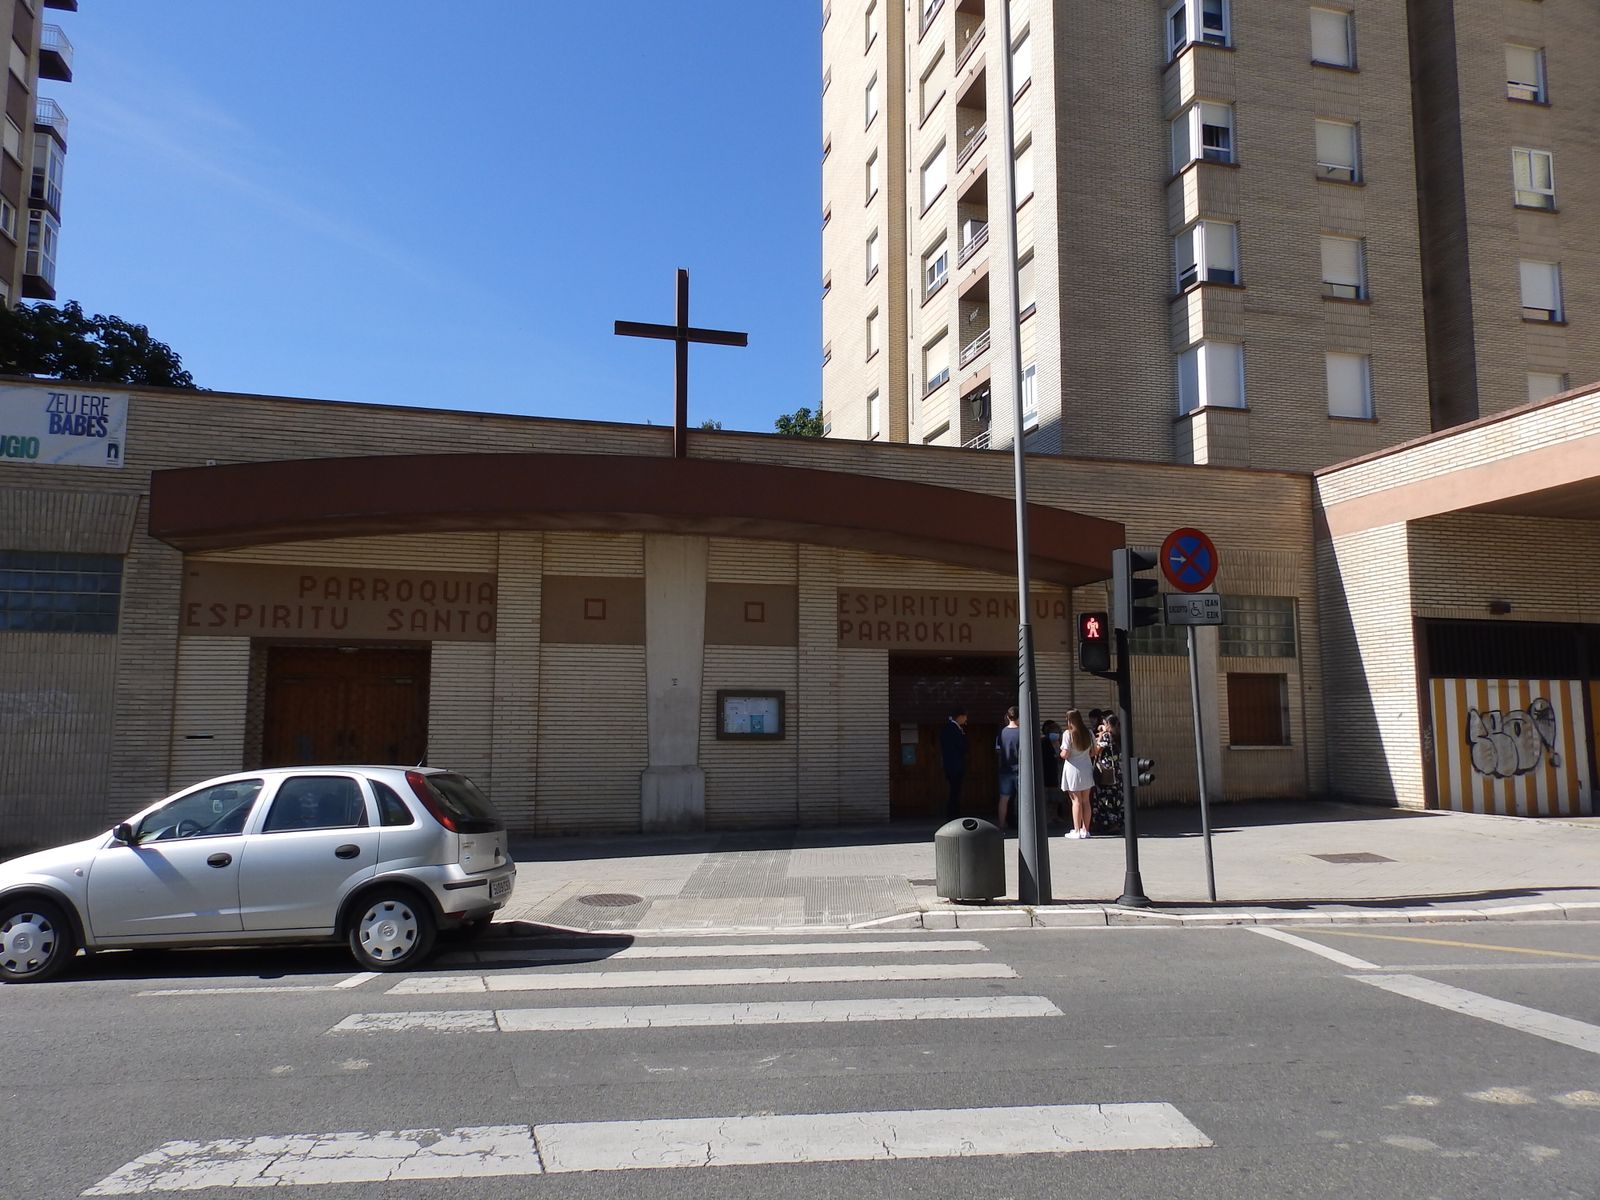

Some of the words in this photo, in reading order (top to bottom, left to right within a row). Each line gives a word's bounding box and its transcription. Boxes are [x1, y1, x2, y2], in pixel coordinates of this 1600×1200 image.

[46, 392, 77, 414] ZEU
[81, 395, 110, 417] ERE
[49, 413, 108, 438] BABES
[299, 575, 495, 606] PARROQUIA
[186, 602, 349, 629] ESPIRITU
[386, 608, 494, 634] SANTO
[838, 593, 959, 618] ESPIRITU
[968, 599, 1067, 620] SANUA
[838, 619, 973, 644] PARROKIA
